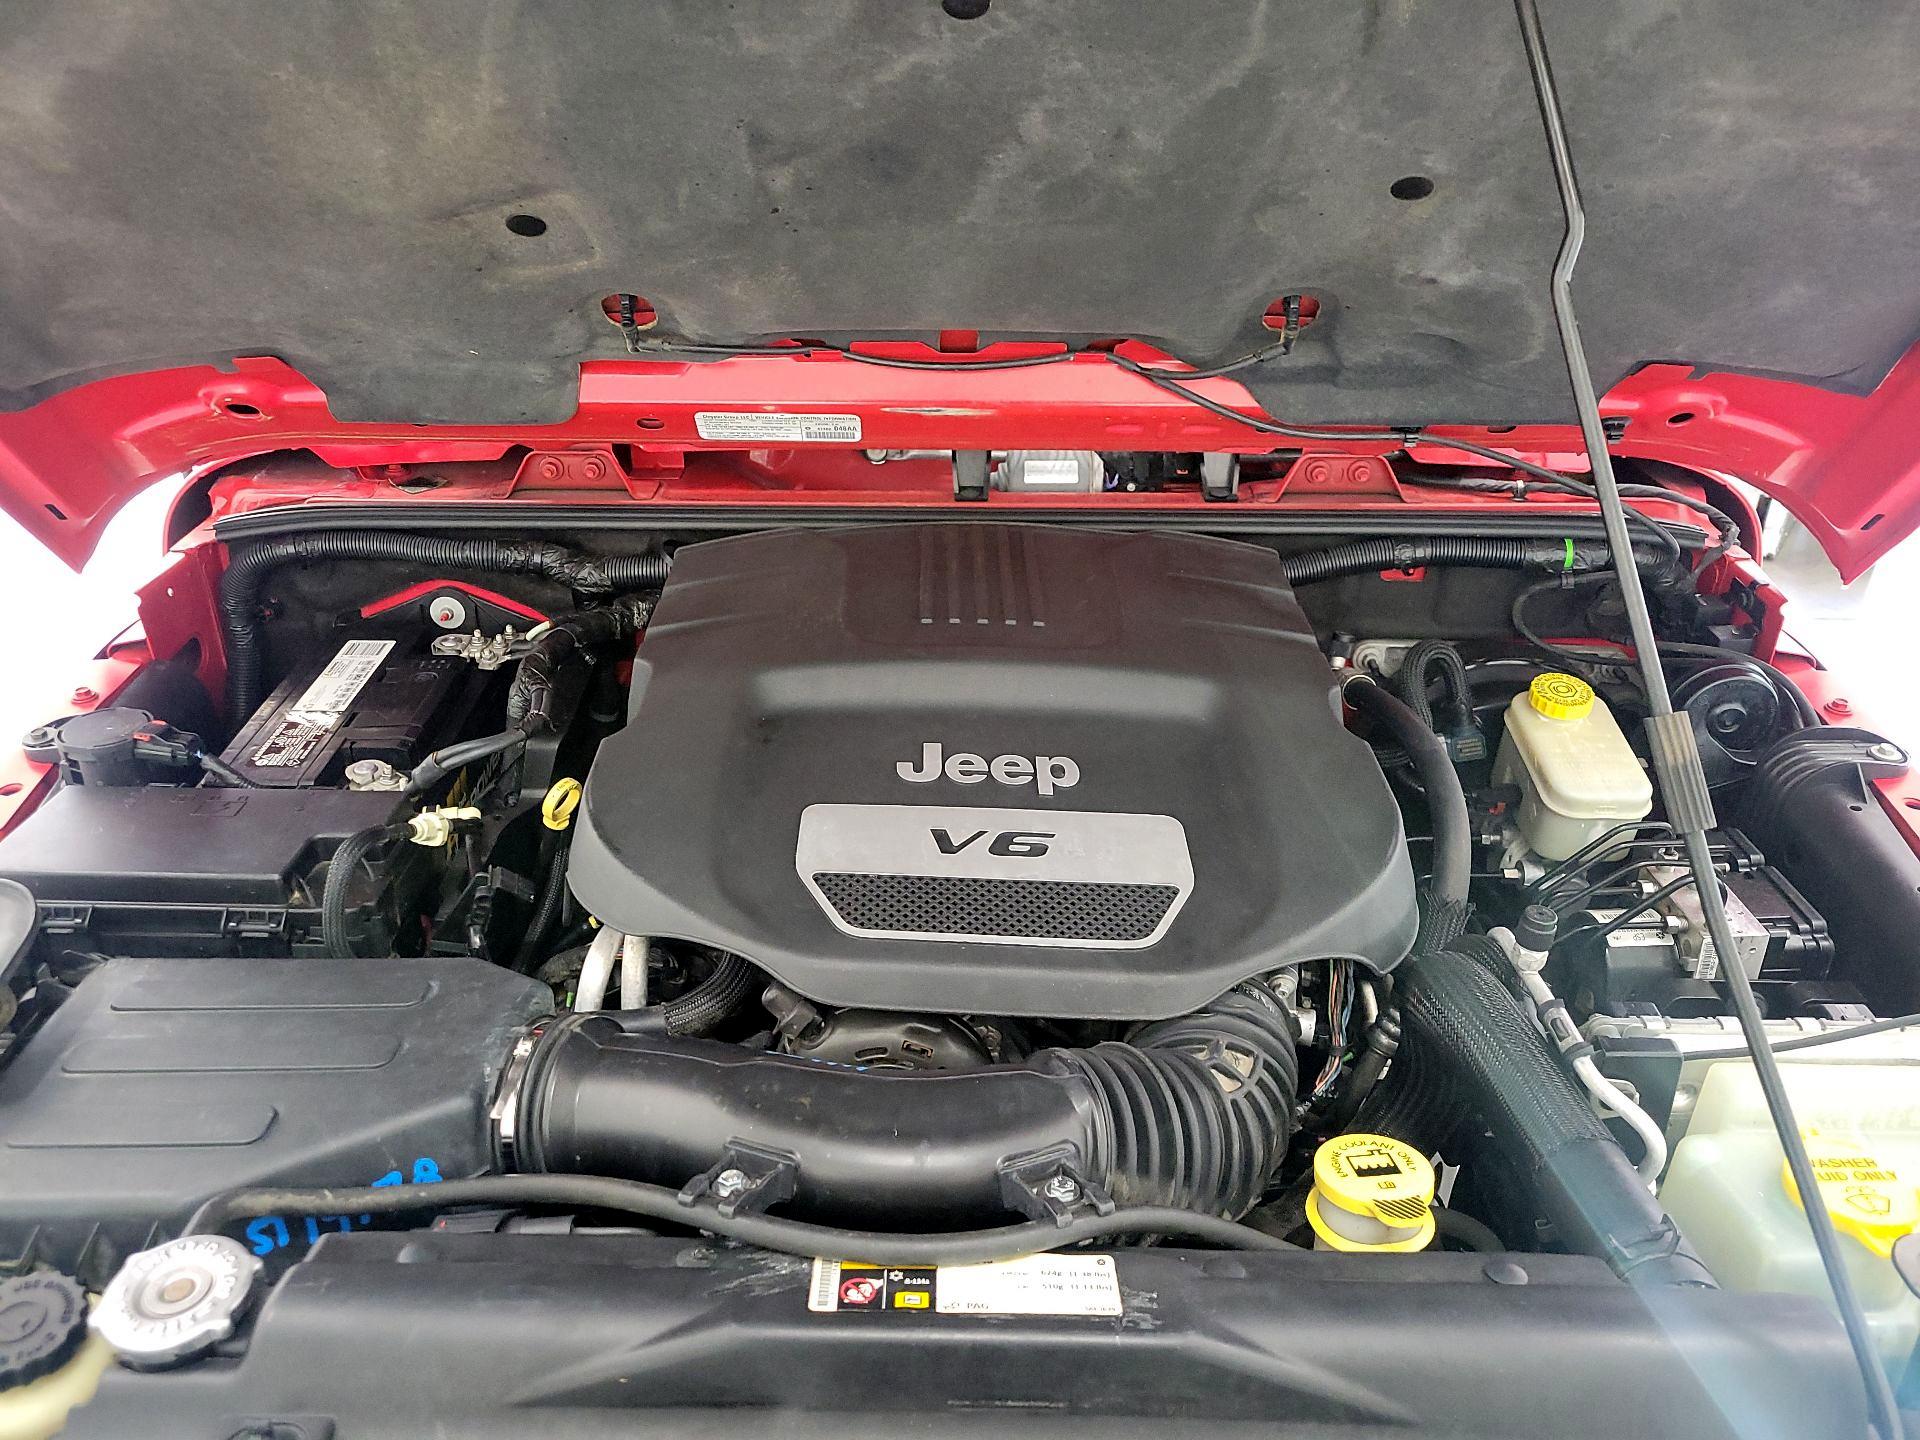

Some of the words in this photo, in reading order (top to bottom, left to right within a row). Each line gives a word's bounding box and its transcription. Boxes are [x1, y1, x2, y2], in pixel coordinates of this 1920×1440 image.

[896, 742, 1080, 796] Jeep
[929, 828, 1057, 858] V6
[1330, 1151, 1348, 1177] ENGINE
[1339, 1140, 1394, 1150] COOLANT
[1397, 1151, 1416, 1171] ONLY
[1811, 1158, 1878, 1168] ASHER
[1816, 1170, 1848, 1181] UID
[1853, 1171, 1897, 1181] ONLY
